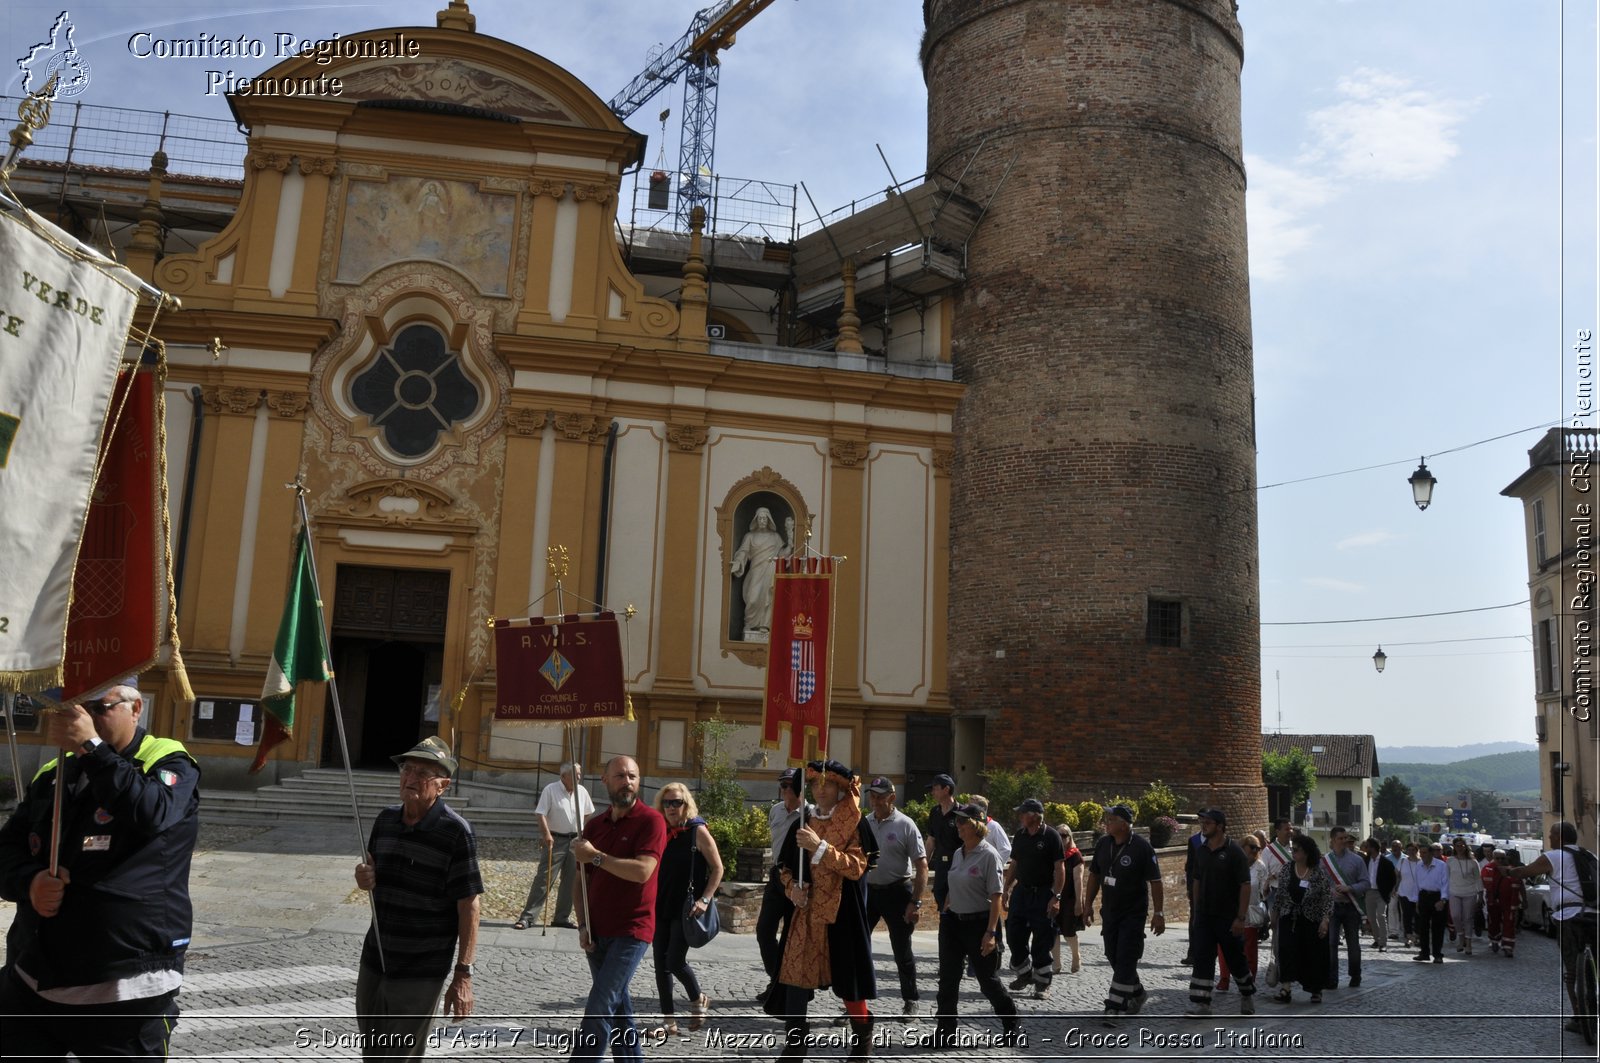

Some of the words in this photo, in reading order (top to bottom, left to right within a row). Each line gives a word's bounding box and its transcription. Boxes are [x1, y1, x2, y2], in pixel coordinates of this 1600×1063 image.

[22, 271, 104, 327] VERDE
[0, 309, 24, 338] E
[121, 416, 148, 463] CIVILE
[521, 631, 592, 649] A.VI.S.
[501, 704, 521, 715] SAN
[528, 704, 572, 714] DAMIANO
[593, 701, 617, 712] ASTI
[540, 692, 579, 703] COMUNALE
